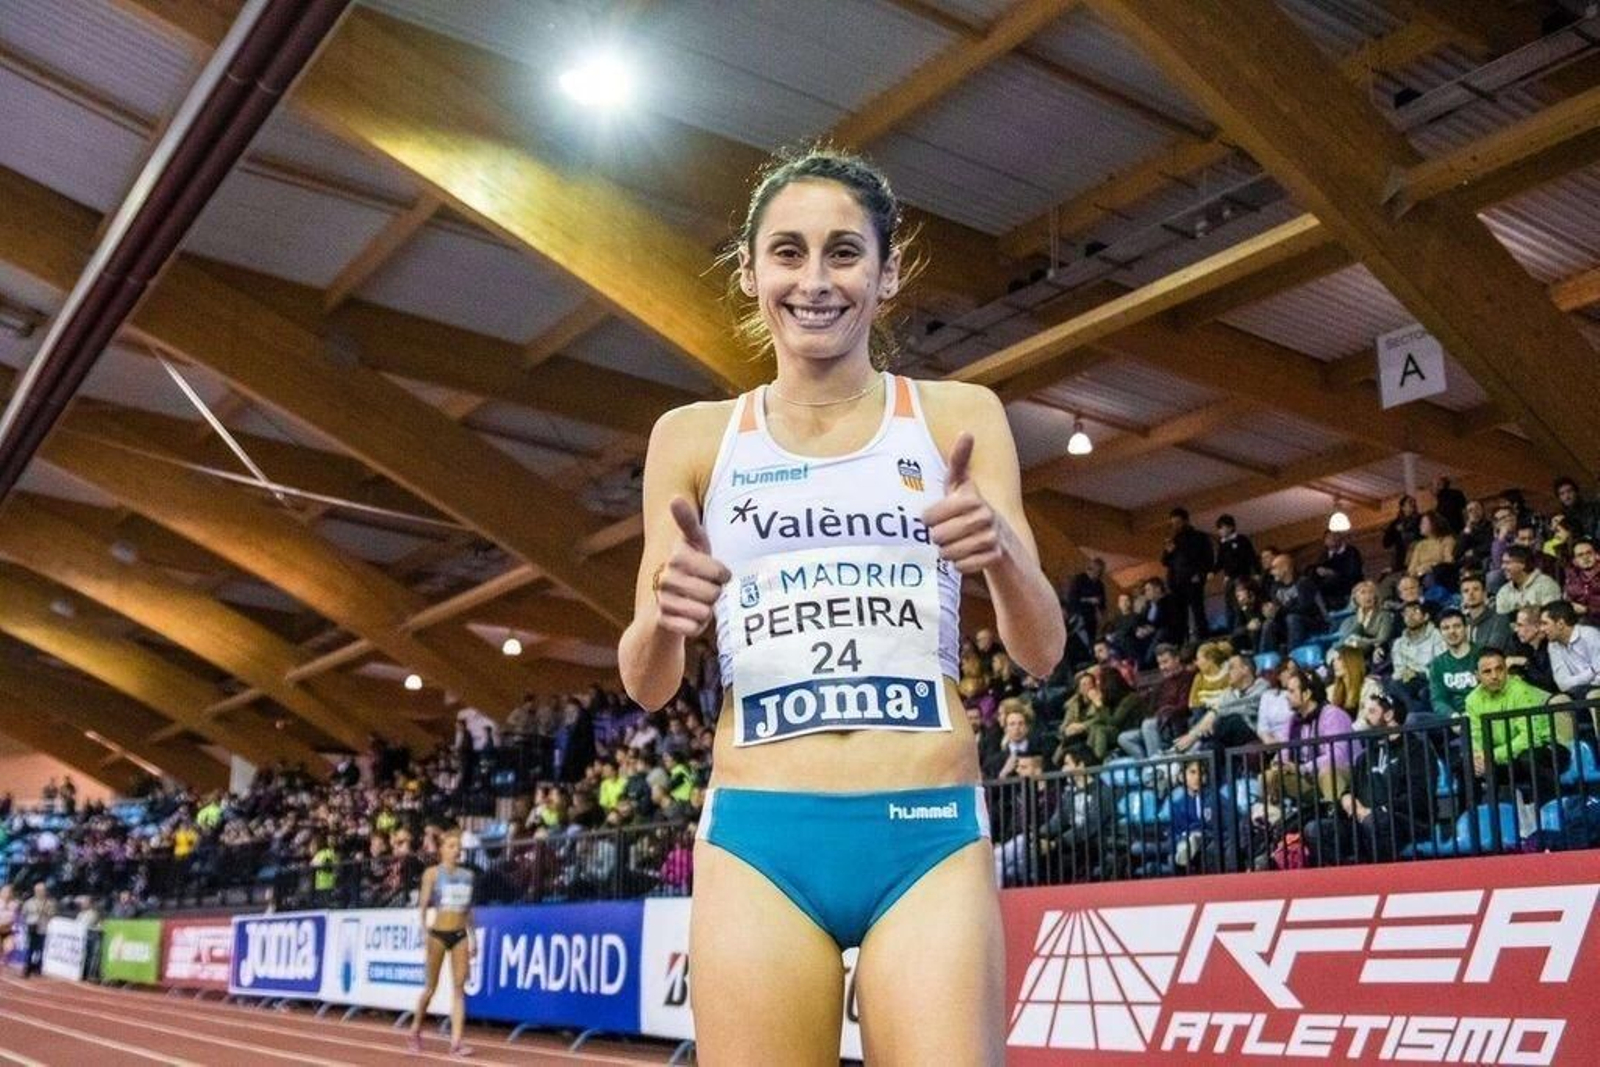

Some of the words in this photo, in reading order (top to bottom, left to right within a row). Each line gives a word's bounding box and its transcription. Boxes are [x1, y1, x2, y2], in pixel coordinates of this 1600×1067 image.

[1385, 329, 1428, 350] SECTO
[1400, 352, 1426, 388] A
[732, 464, 809, 487] hummel
[752, 505, 931, 545] València
[780, 562, 924, 594] MADRID
[744, 596, 924, 646] PEREIRA
[811, 639, 863, 675] 24
[889, 801, 959, 820] hummel
[1177, 882, 1600, 1009] RFEA
[501, 933, 627, 996] MADRID
[1160, 1010, 1568, 1066] ATLETISMO
